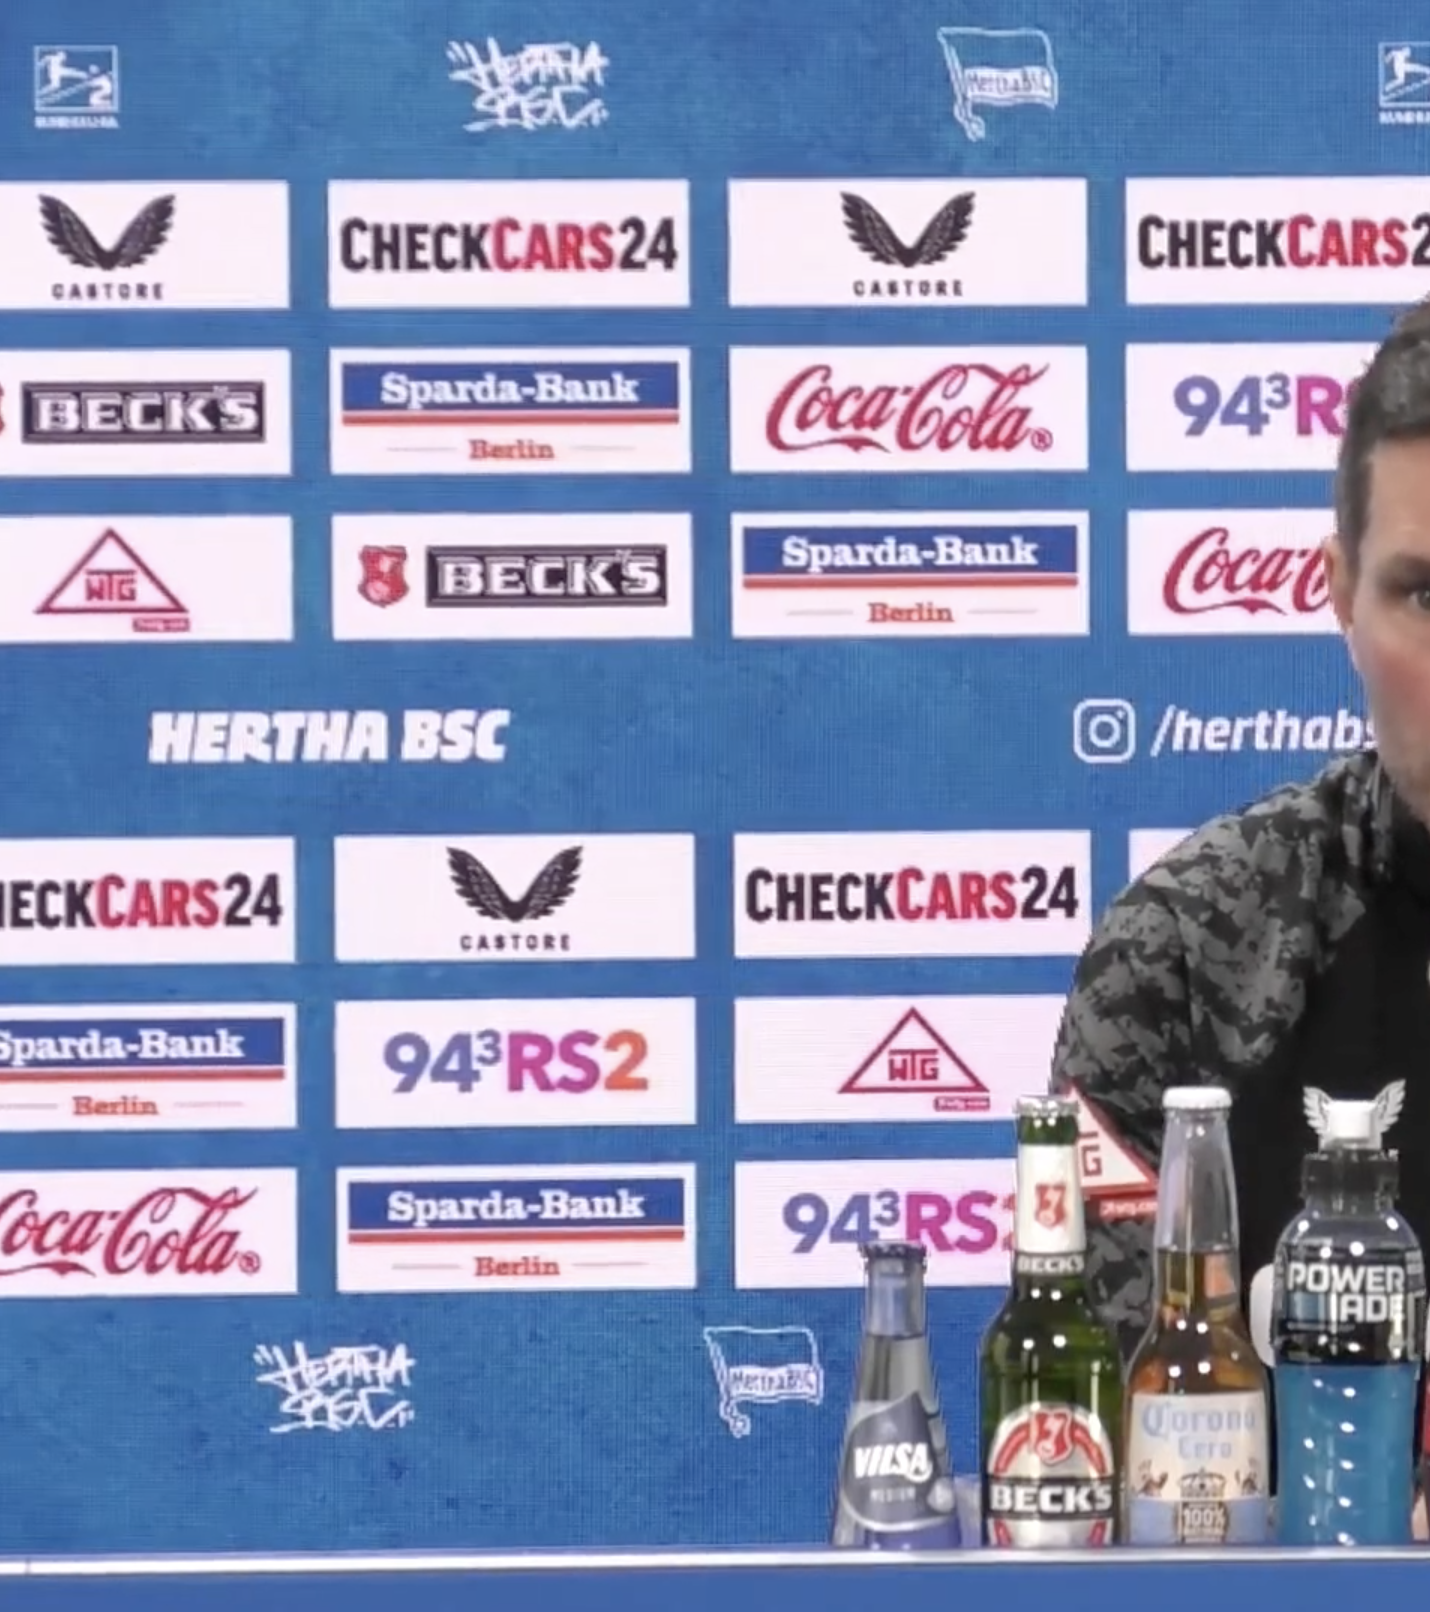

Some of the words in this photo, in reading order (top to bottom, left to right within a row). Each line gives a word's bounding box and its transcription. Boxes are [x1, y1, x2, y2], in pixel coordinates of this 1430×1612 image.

[341, 216, 678, 272] CHECKCARS24
[52, 283, 162, 300] CASTORE
[853, 280, 962, 296] CASTORE
[381, 372, 639, 409] Sparda-Bank
[469, 439, 555, 460] Berlin
[782, 536, 1039, 573] Sparda-Bank
[84, 568, 138, 601] WTG
[868, 602, 954, 623] Berlin
[149, 710, 388, 763] HERTHA
[401, 709, 510, 762] BSC
[746, 865, 1079, 923] CHECKCARS24
[460, 934, 569, 951] CASTORE
[888, 1049, 939, 1081] WTG
[72, 1095, 159, 1116] Berlin
[388, 1189, 645, 1226] Sparda-Bank
[474, 1256, 560, 1277] Berlin
[1288, 1263, 1405, 1294] POWER
[854, 1442, 932, 1482] VILSA
